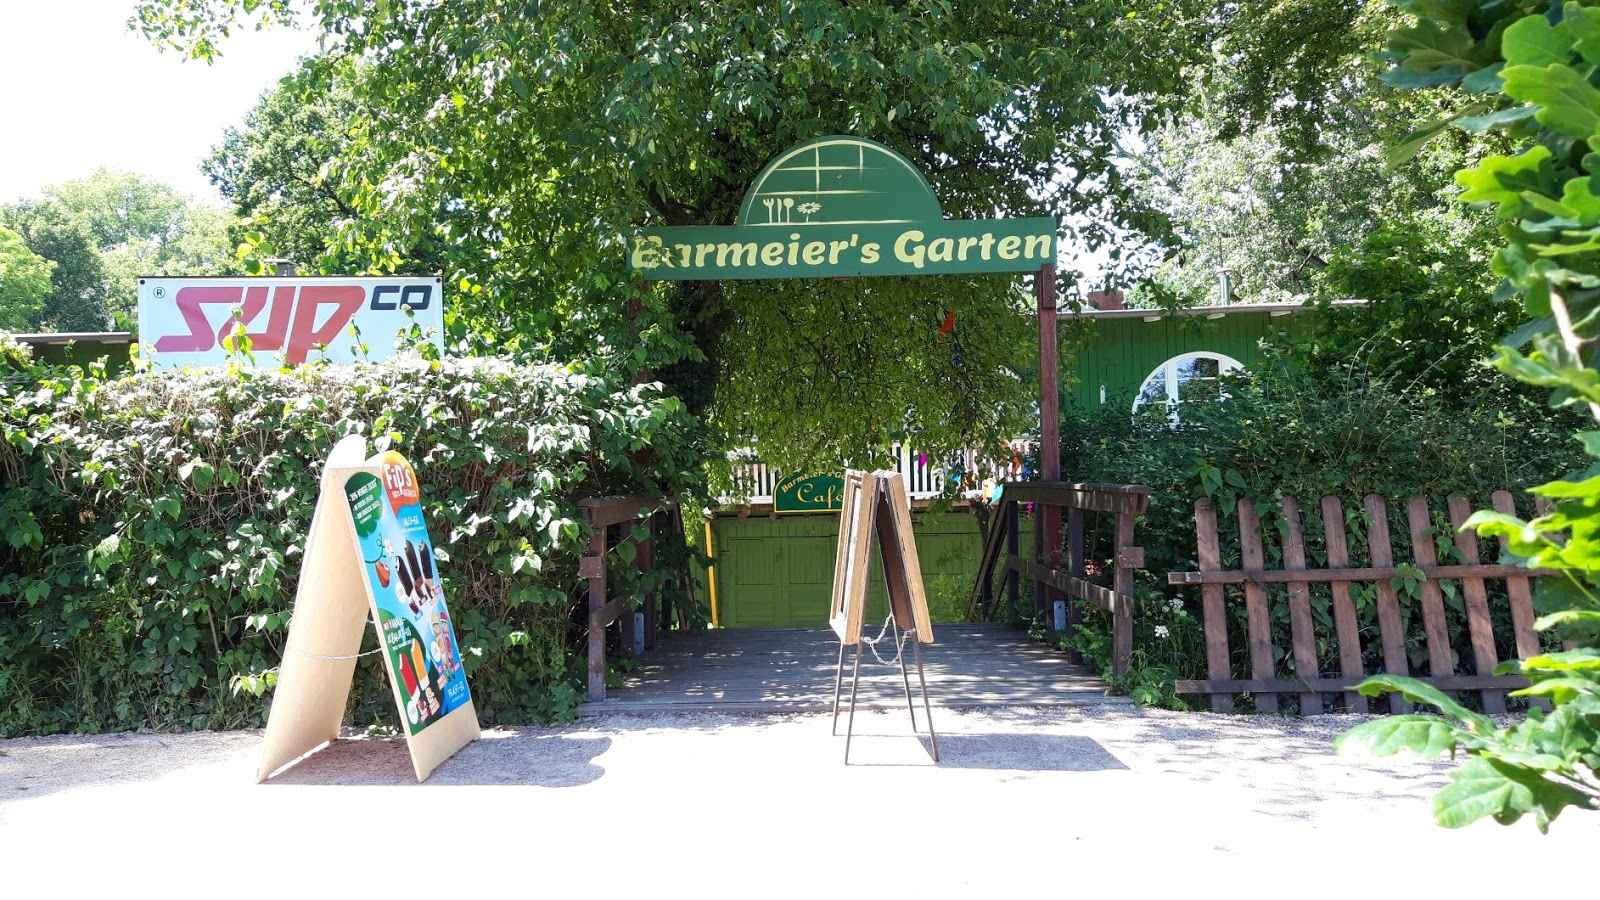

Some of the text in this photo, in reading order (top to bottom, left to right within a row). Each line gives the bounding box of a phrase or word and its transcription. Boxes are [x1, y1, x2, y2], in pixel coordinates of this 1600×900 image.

[631, 229, 1052, 269] Barmeier's Garten
[383, 463, 413, 496] Fip's
[781, 470, 832, 493] Barmeers
